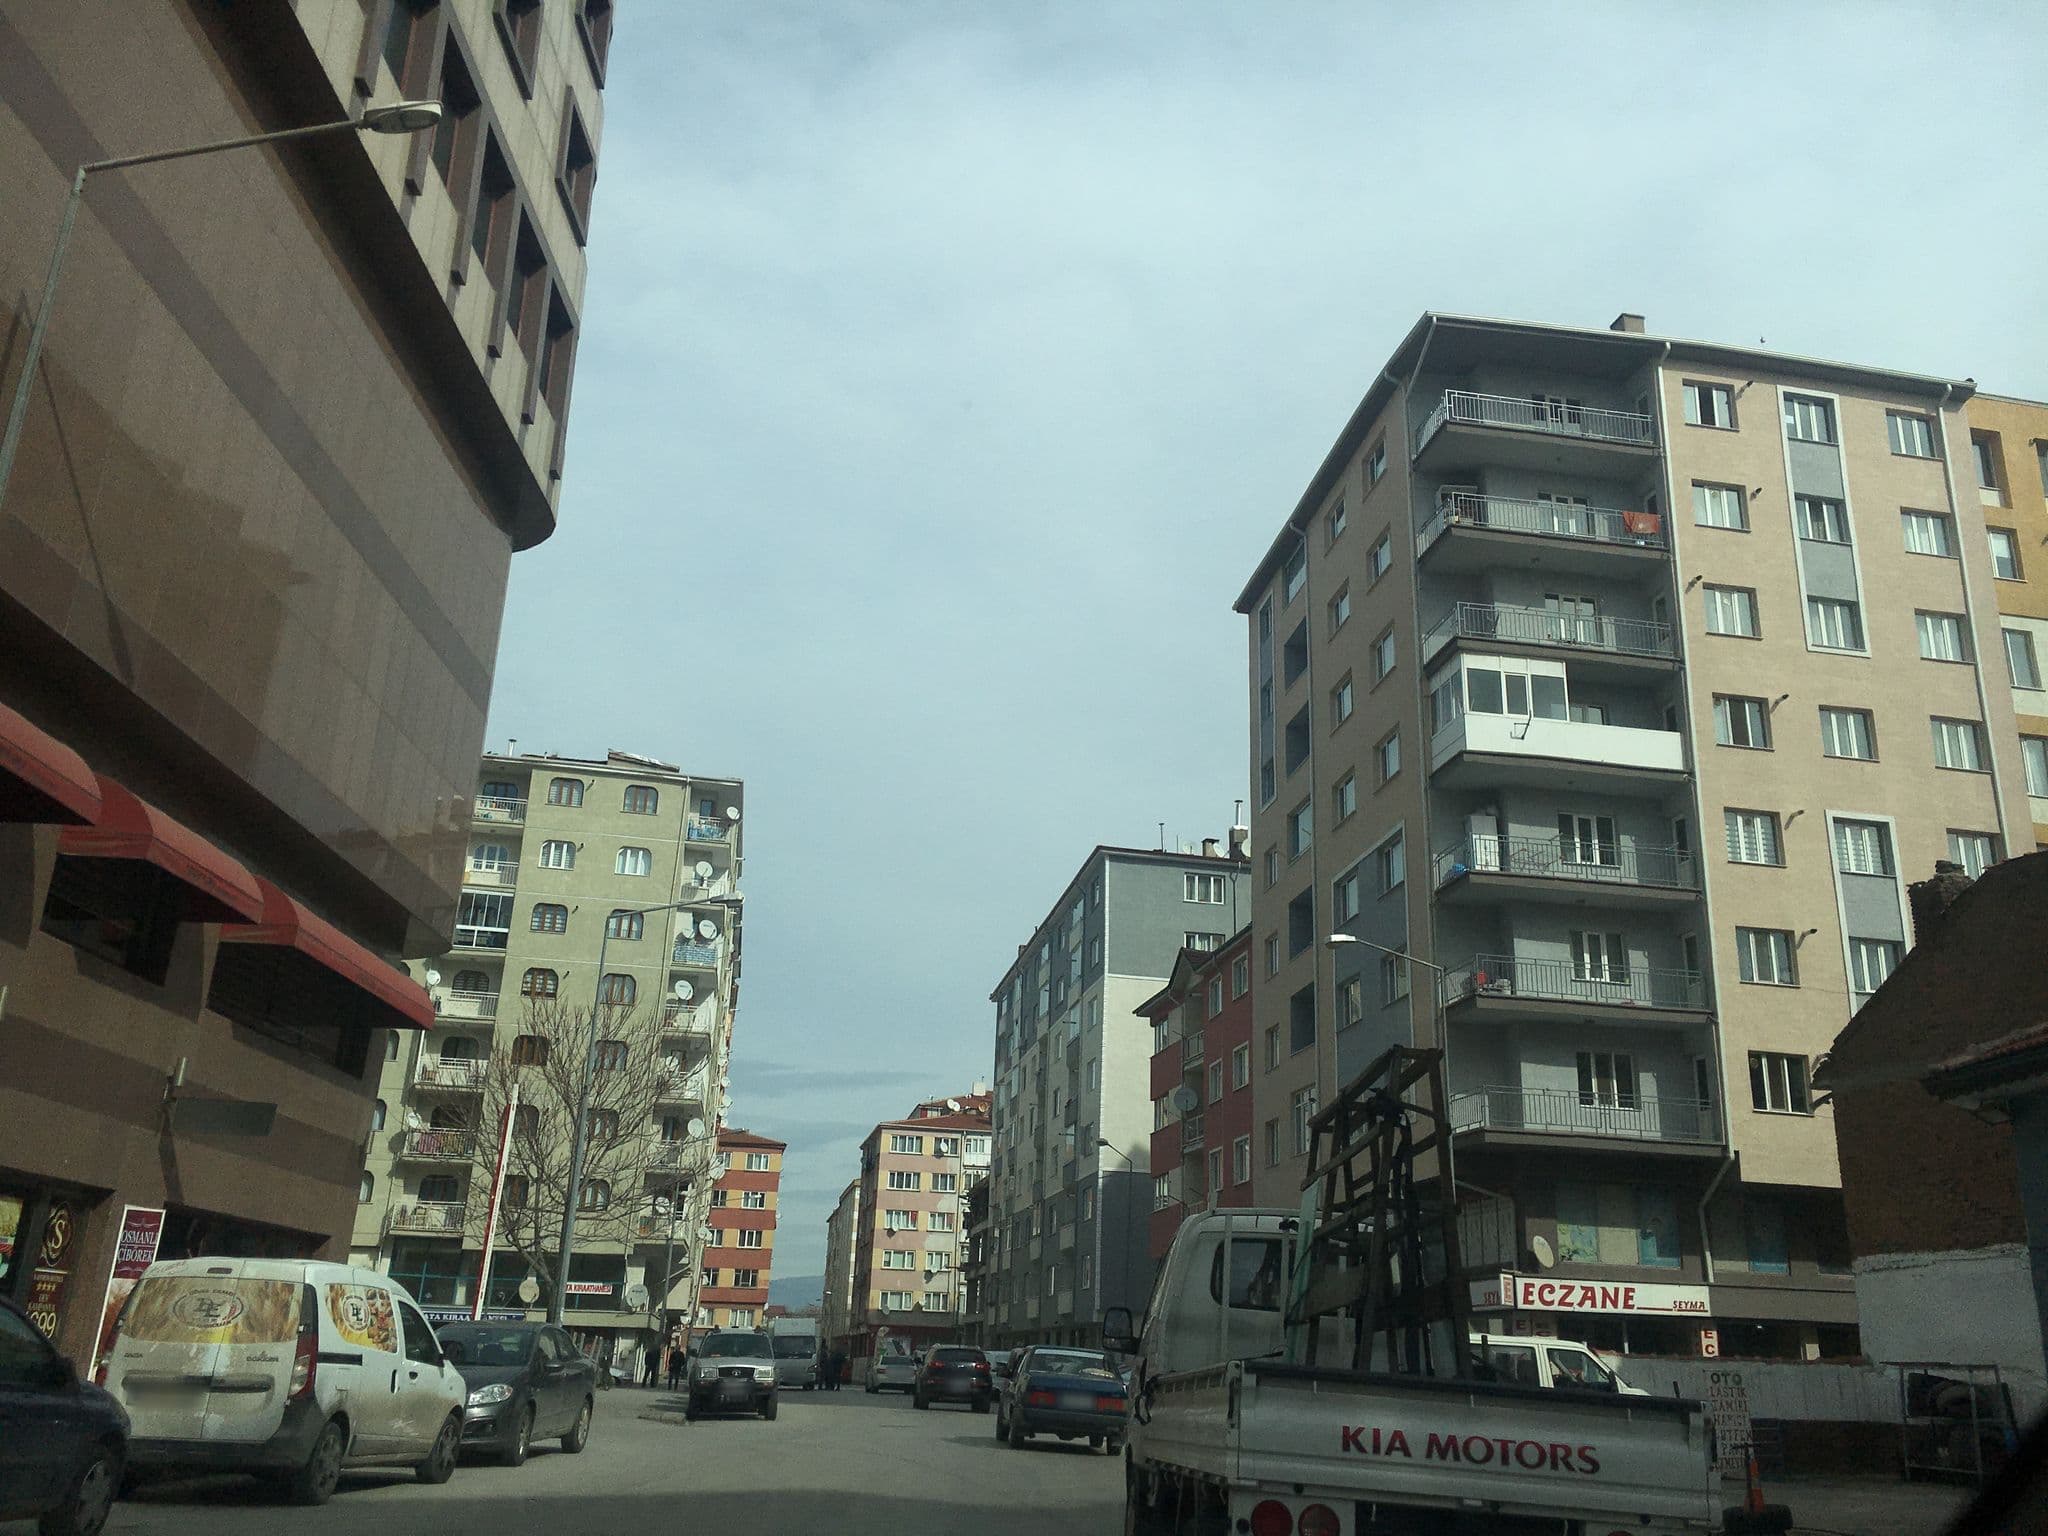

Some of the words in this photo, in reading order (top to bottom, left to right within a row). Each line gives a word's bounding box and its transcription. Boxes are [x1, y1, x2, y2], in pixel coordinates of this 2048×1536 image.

[1523, 1283, 1636, 1309] ECZANE
[1710, 1371, 1742, 1385] OTO
[1342, 1425, 1412, 1458] KIA
[1425, 1432, 1600, 1474] MOTORS
